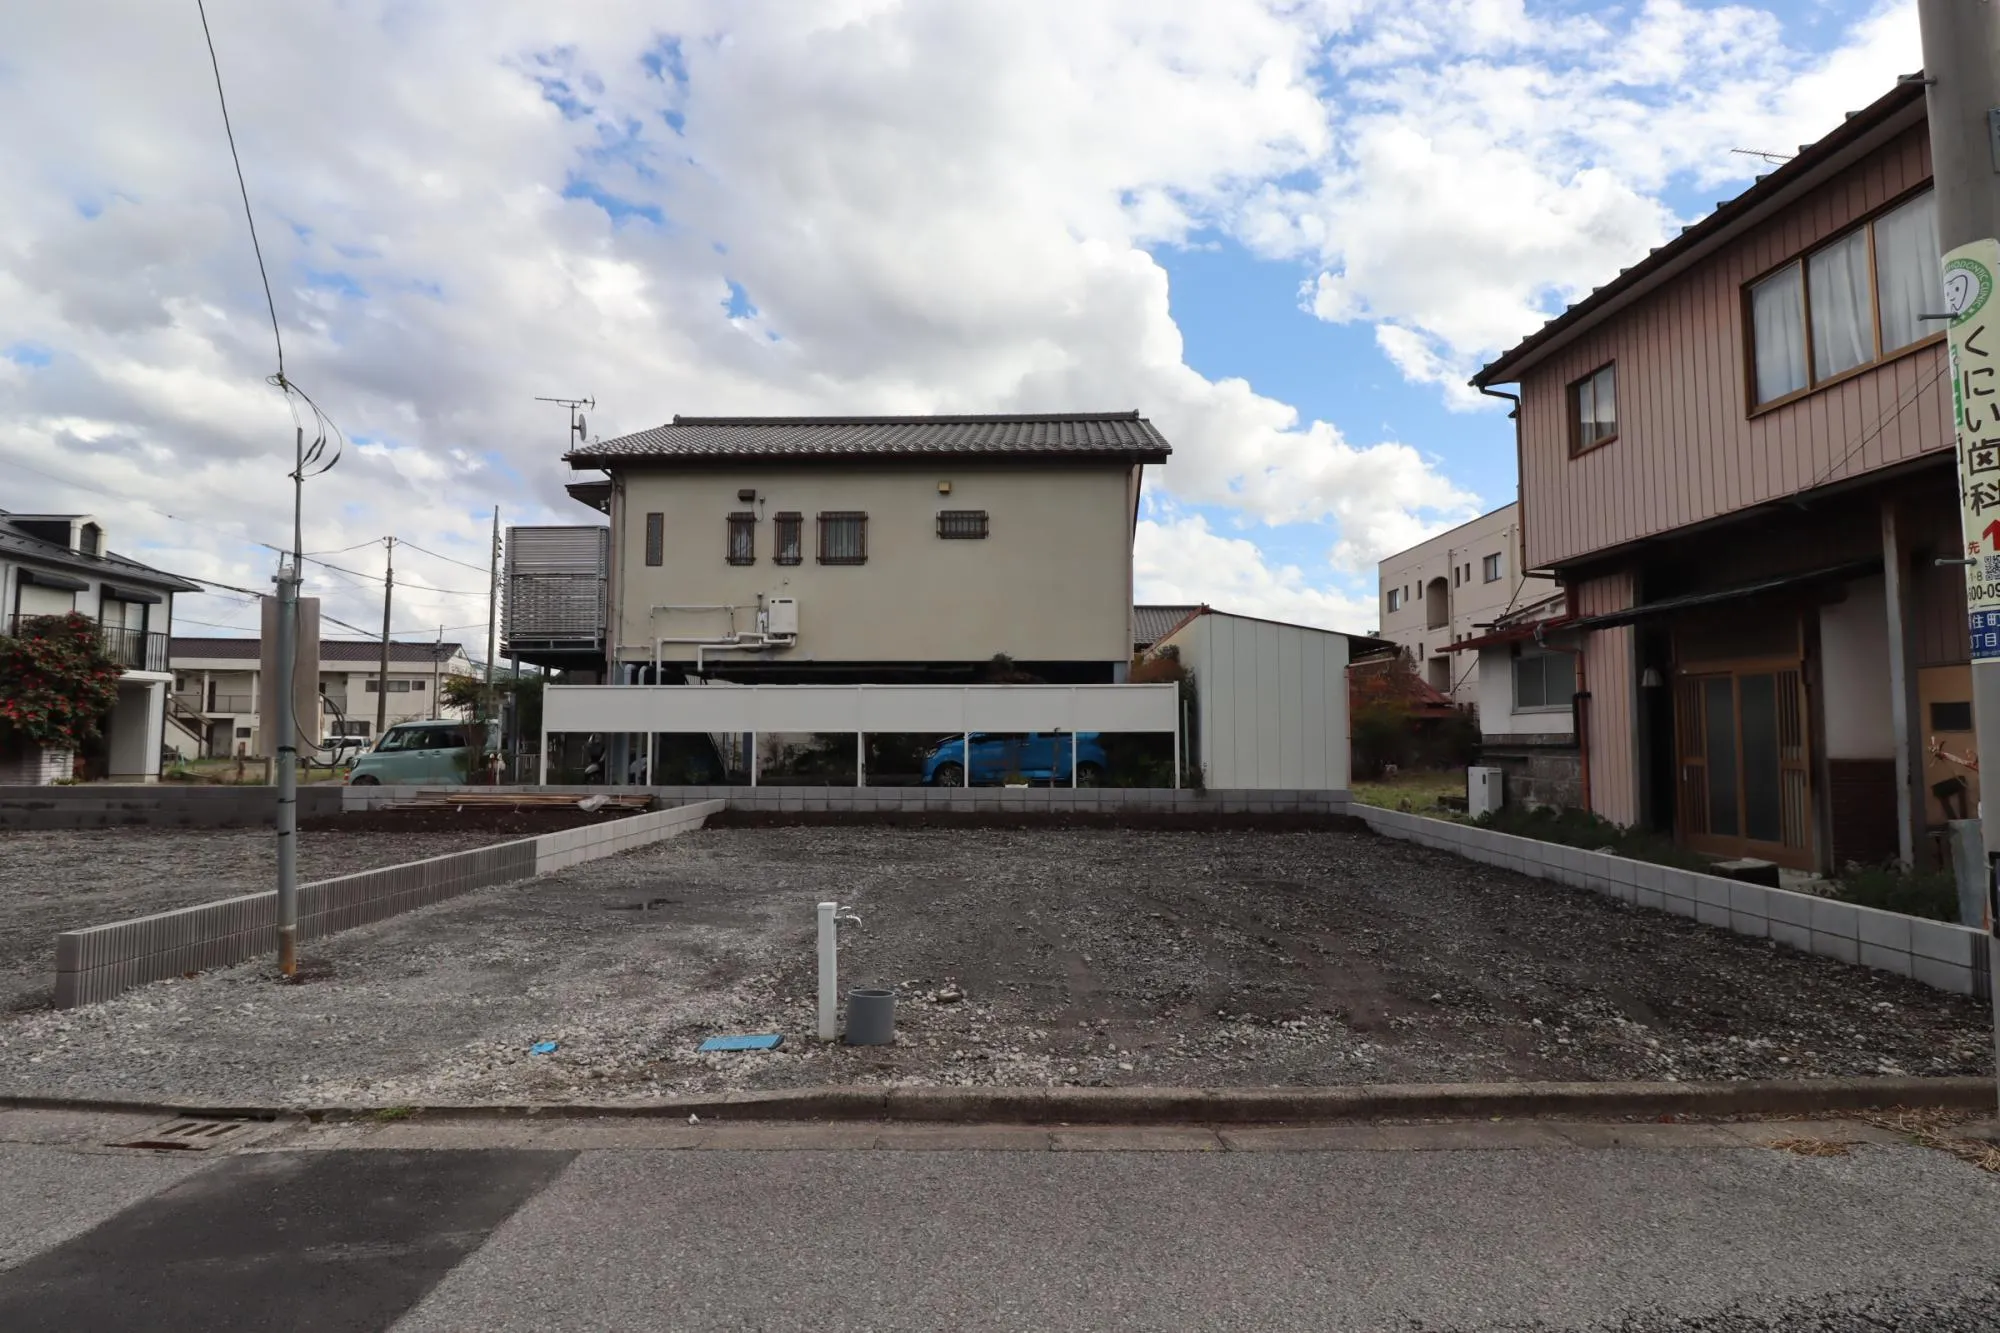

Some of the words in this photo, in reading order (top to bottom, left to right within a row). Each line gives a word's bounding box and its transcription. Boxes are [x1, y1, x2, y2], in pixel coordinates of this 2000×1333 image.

[1964, 325, 2000, 516] くにい歯科
[1968, 541, 1980, 555] 先
